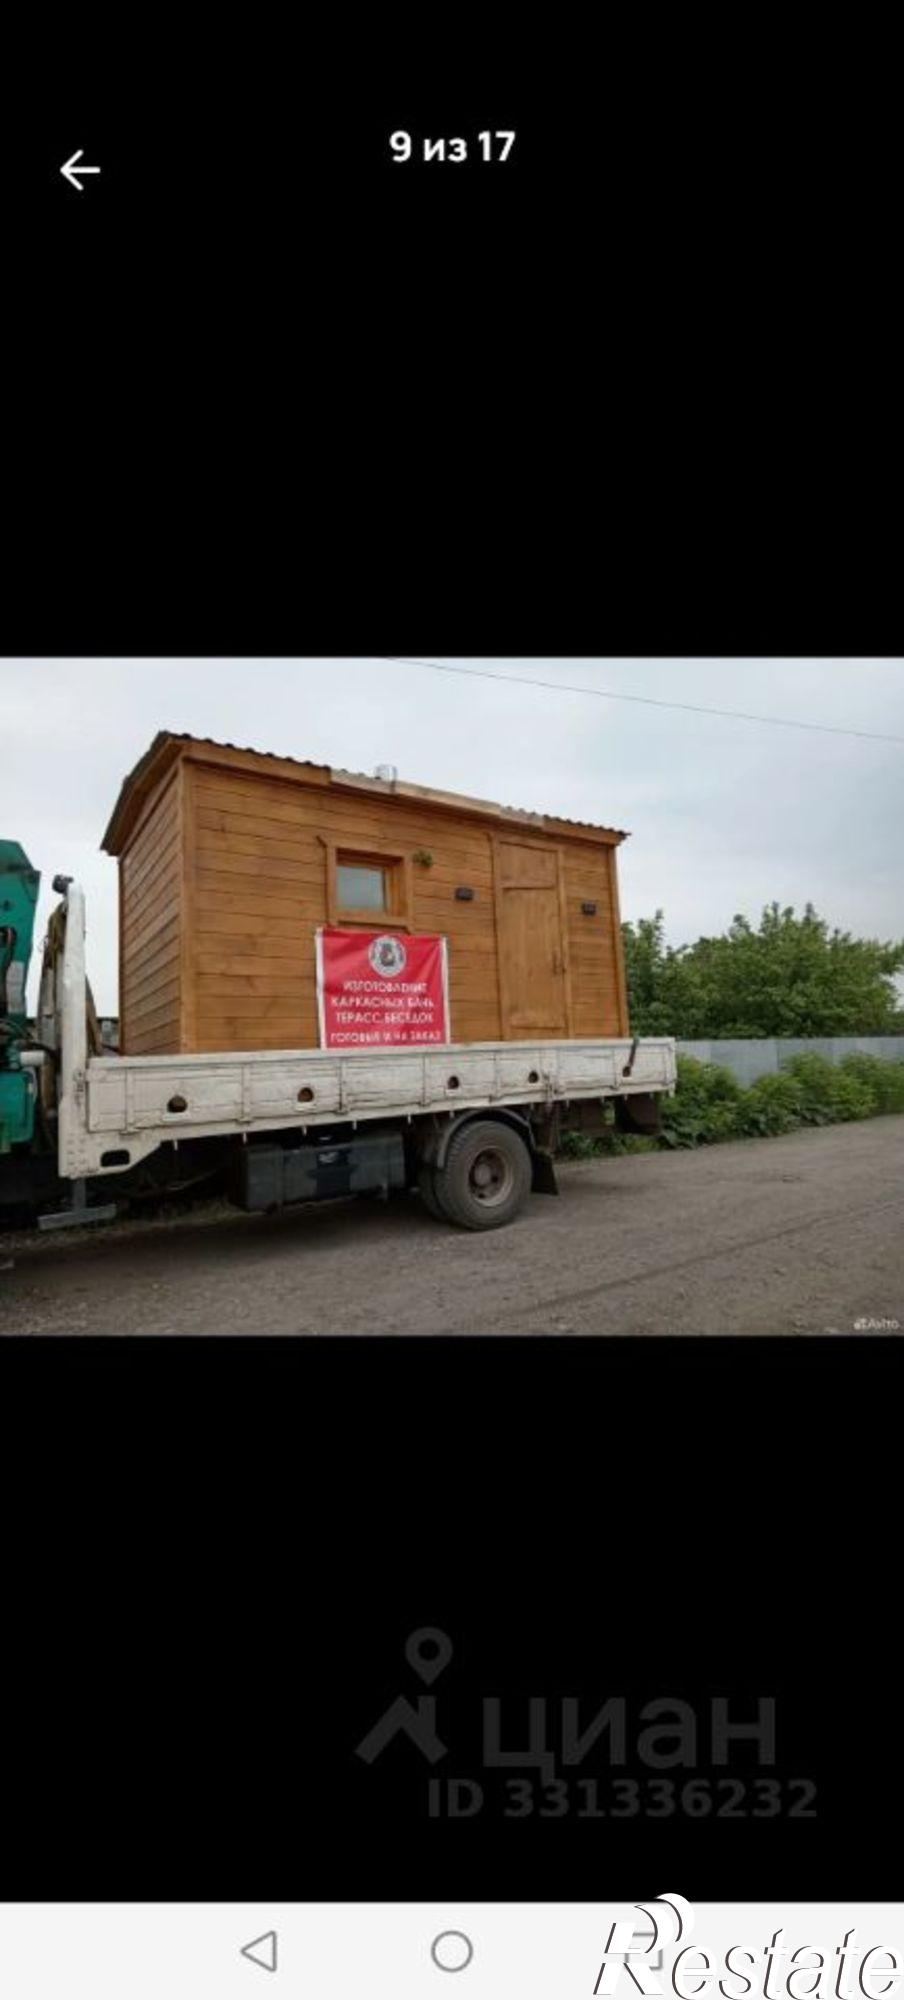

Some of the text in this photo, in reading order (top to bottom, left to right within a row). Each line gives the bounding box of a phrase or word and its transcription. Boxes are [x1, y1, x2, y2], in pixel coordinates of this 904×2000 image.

[390, 131, 515, 162] 9 из 17
[331, 996, 404, 1007] КАРКАСНЫХ
